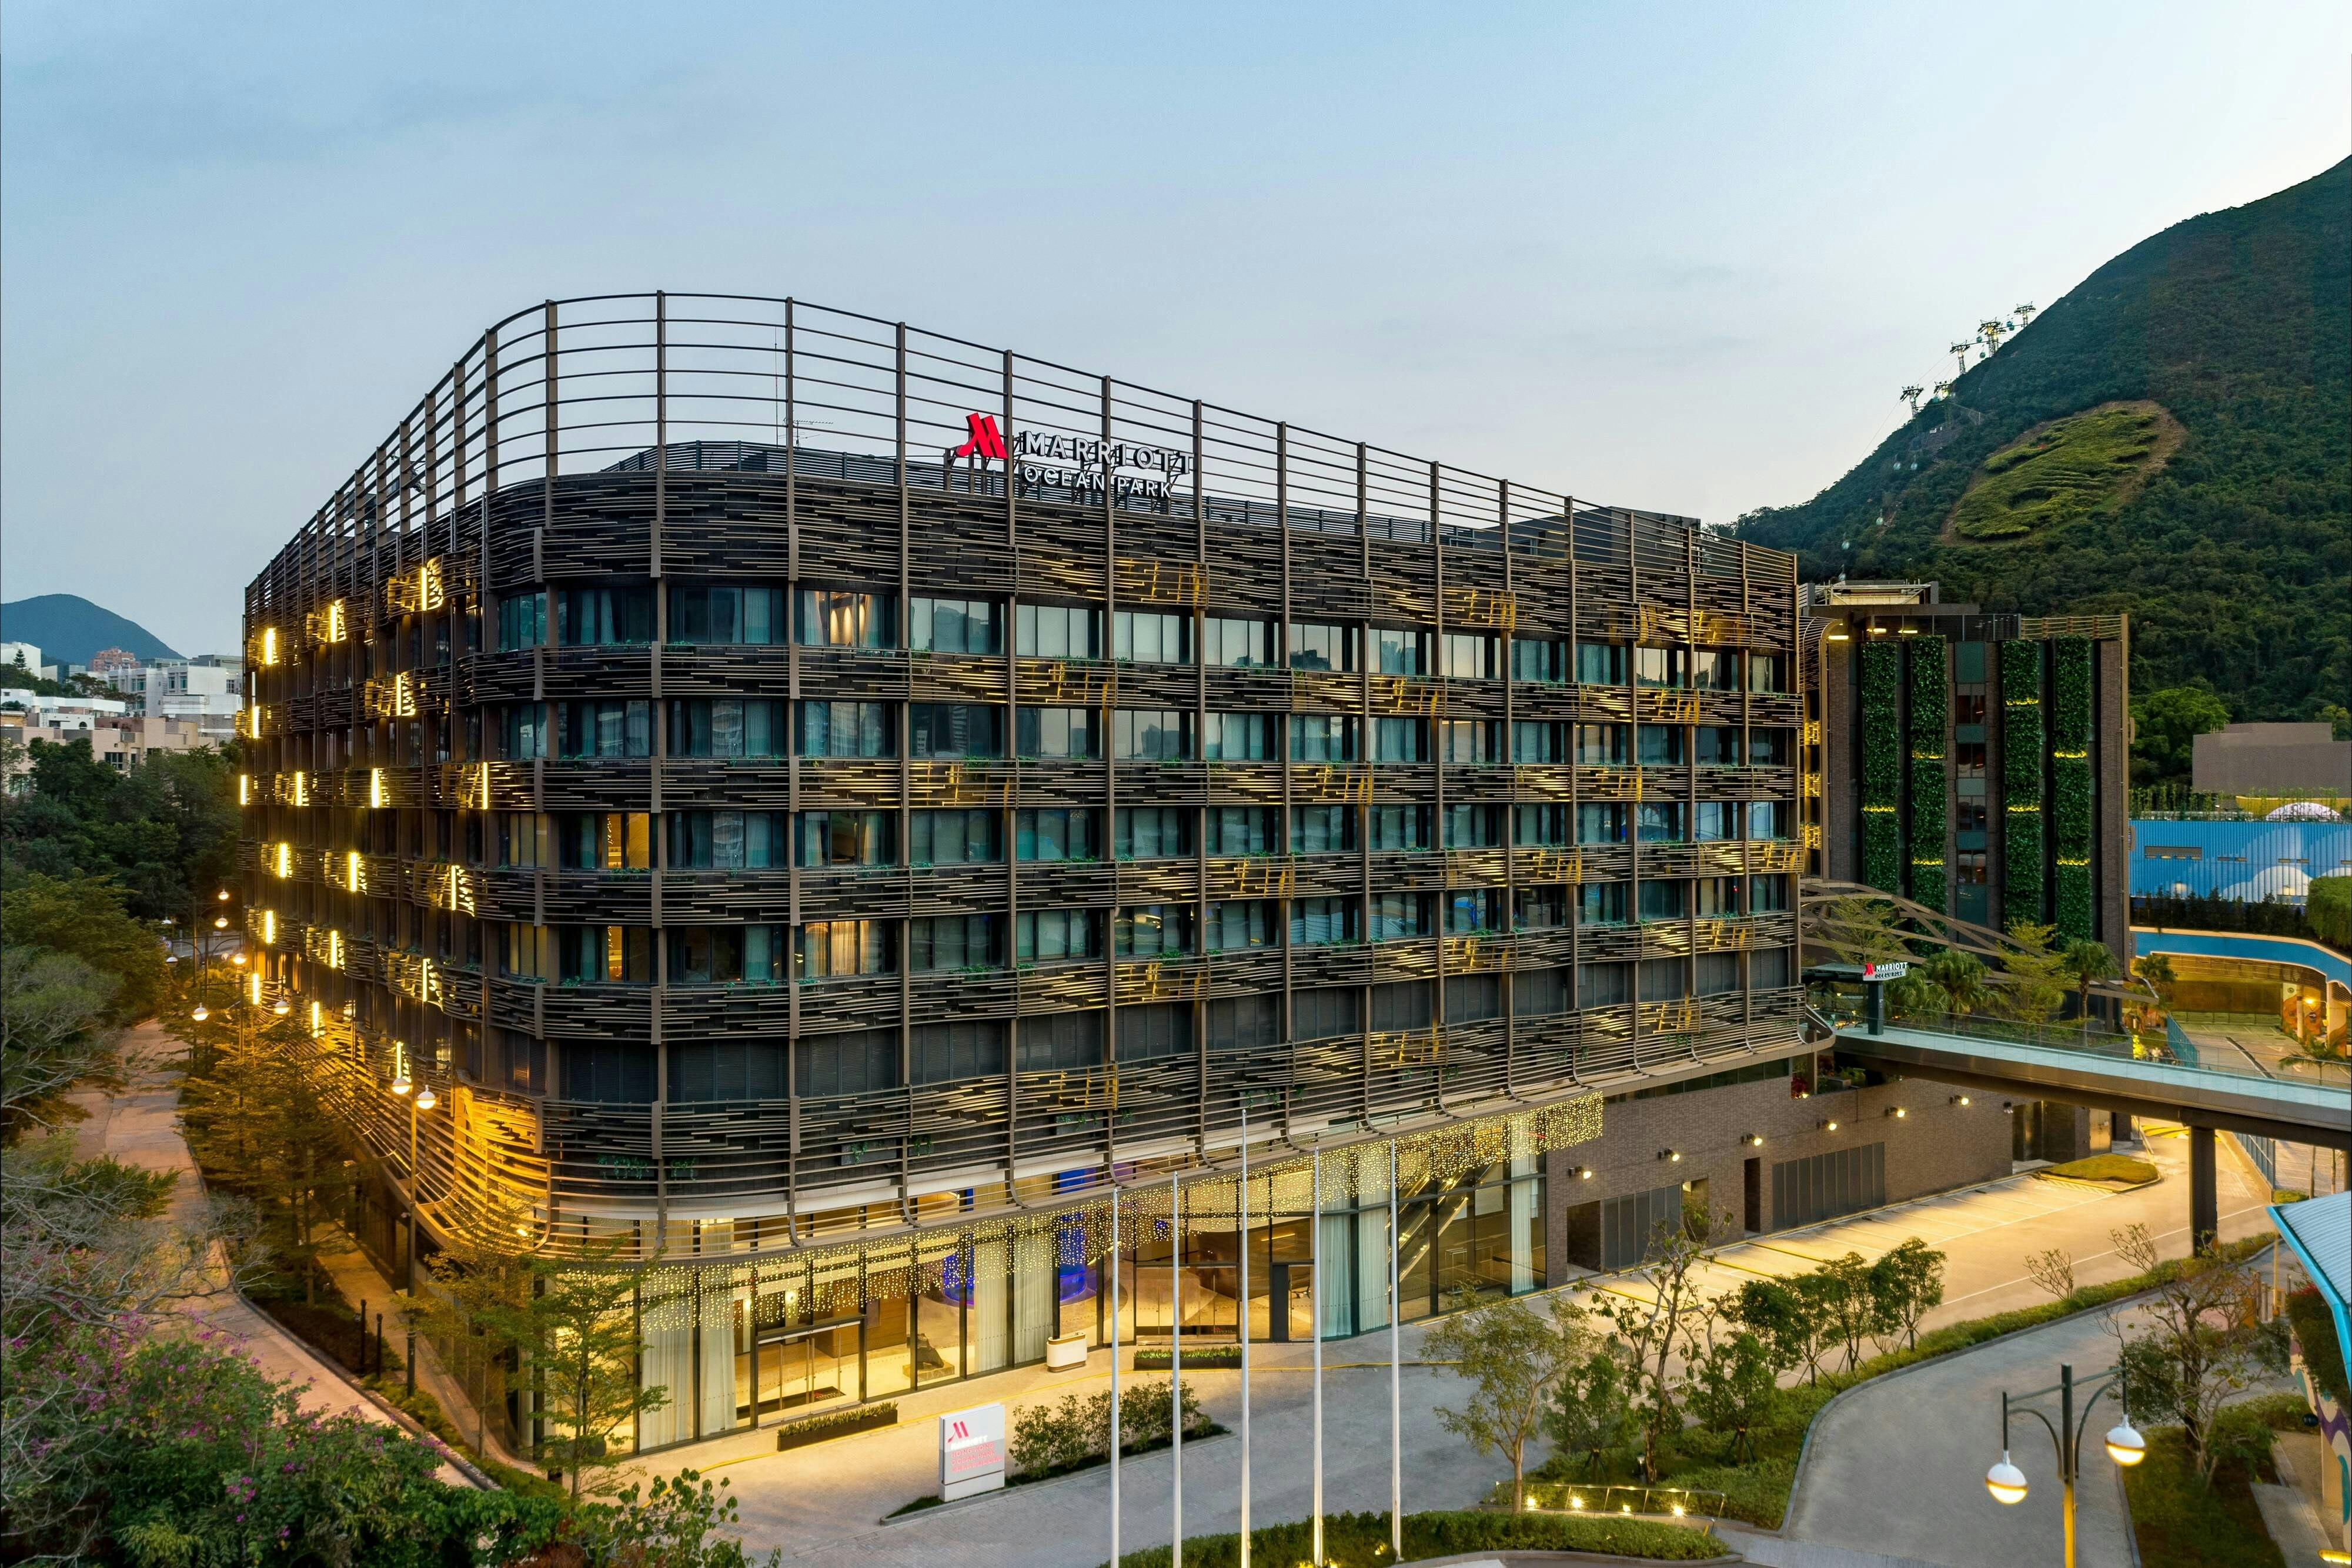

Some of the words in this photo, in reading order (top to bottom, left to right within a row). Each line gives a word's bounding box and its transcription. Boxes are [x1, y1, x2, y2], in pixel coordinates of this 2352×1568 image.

[1023, 430, 1194, 474] MARRIOTT
[1022, 466, 1105, 491] OCEAN
[1116, 476, 1171, 499] PARK
[1876, 962, 1907, 972] MARRIOTT
